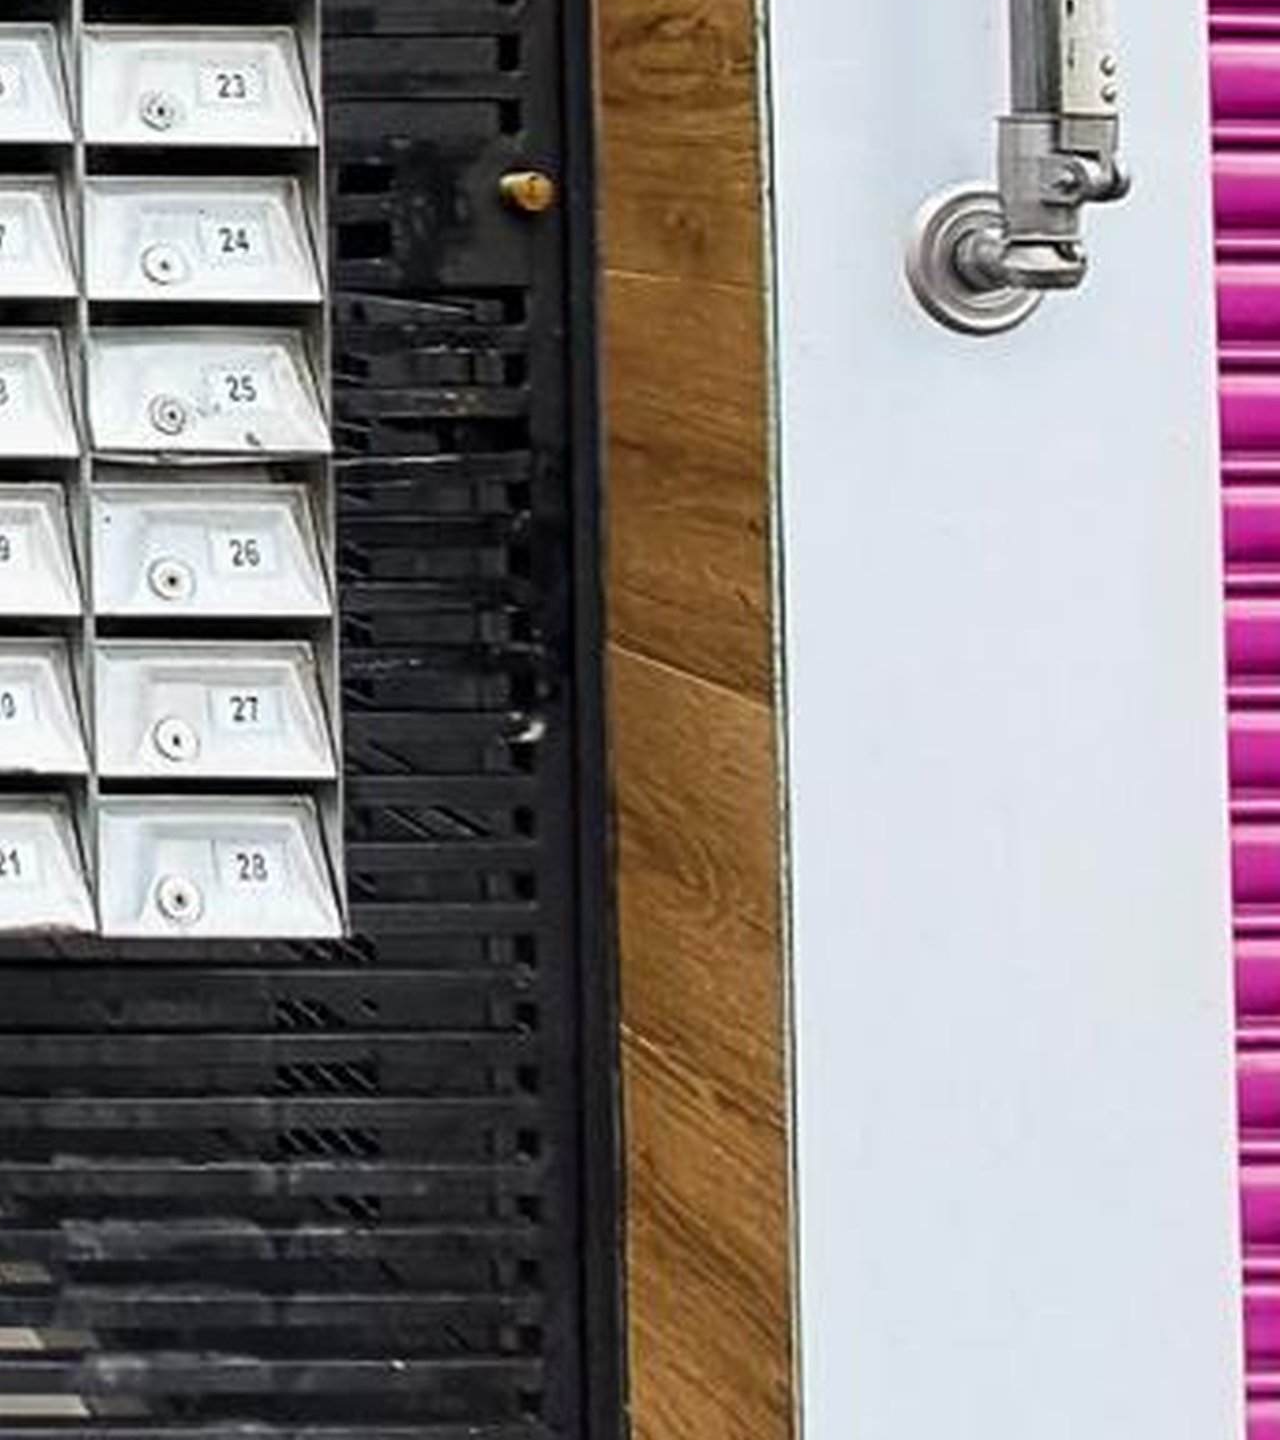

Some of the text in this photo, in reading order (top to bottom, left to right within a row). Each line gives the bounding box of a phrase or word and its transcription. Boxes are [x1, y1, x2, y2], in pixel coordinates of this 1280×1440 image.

[216, 73, 246, 99] 23
[218, 227, 250, 253] 24
[224, 374, 257, 403] 25
[229, 538, 261, 567] 26
[229, 695, 259, 723] 27
[235, 852, 268, 882] 28
